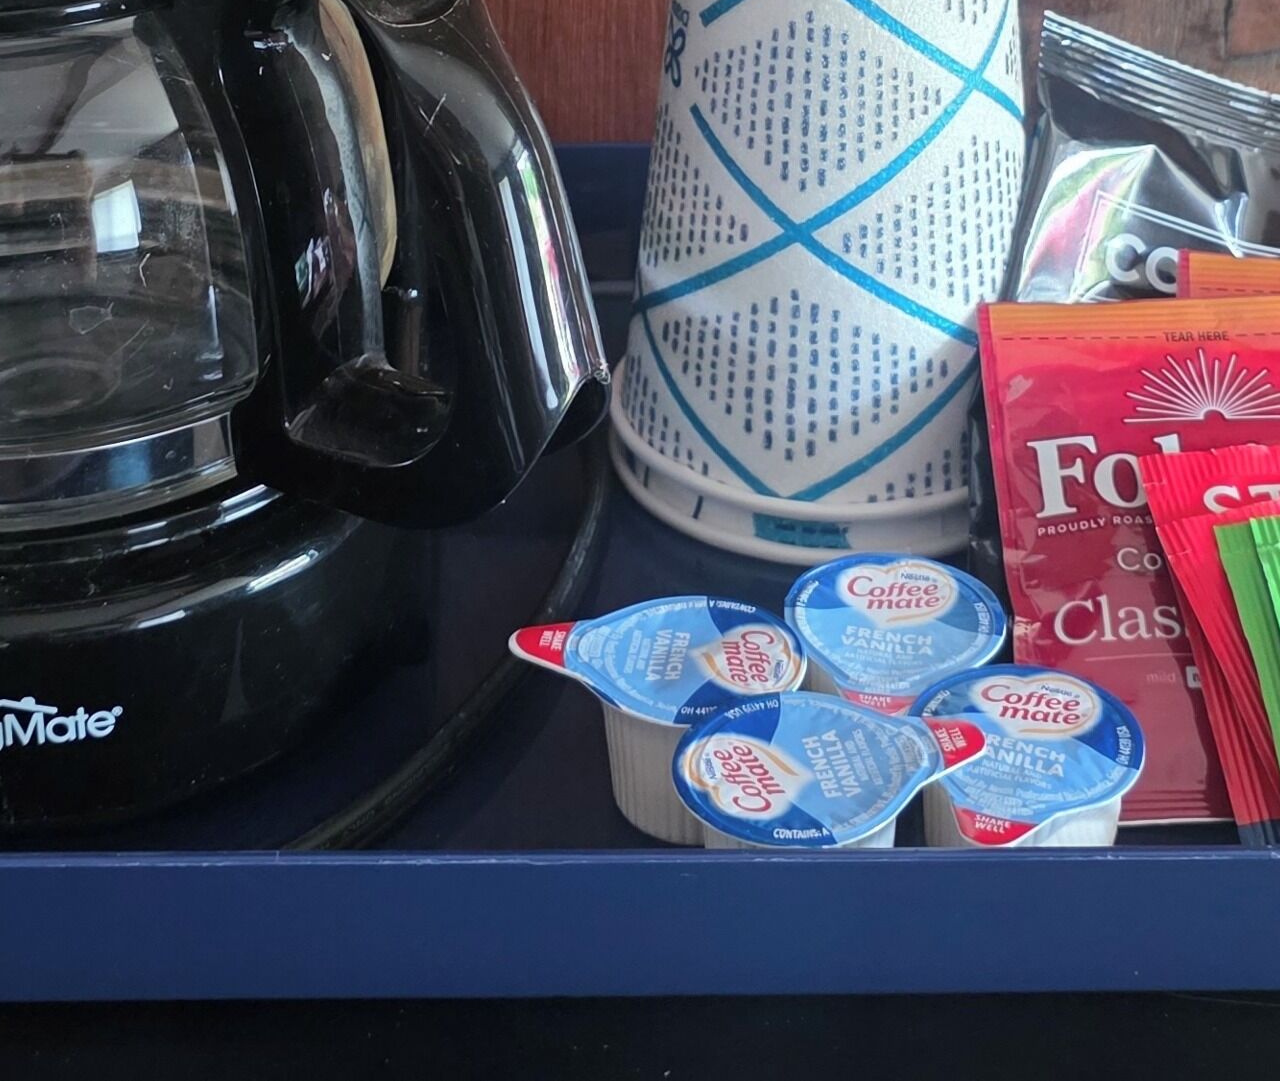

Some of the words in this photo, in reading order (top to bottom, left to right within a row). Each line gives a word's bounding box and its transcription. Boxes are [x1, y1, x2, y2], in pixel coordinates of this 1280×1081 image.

[1105, 233, 1179, 294] CO
[1163, 332, 1195, 343] TEAR
[1198, 330, 1230, 341] HERE
[1026, 433, 1181, 519] Fo
[1037, 517, 1106, 537] PROUDLY
[1117, 547, 1162, 571] Co
[847, 575, 939, 598] Coffee
[867, 595, 941, 610] mate
[1054, 594, 1182, 646] Clas
[538, 630, 554, 647] WELL
[550, 630, 567, 652] SHAKE
[841, 634, 933, 655] VANILLA
[845, 625, 933, 646] FRENCH
[645, 629, 673, 682] VANILLA
[663, 631, 691, 681] FRENCH
[722, 641, 749, 685] mate
[741, 630, 775, 684] Coffee
[981, 683, 1081, 711] Coffee
[999, 703, 1081, 725] mate
[934, 727, 955, 752] SHAKE
[949, 727, 968, 749] WELL
[986, 734, 1066, 763] RENCH
[734, 745, 786, 796] mate
[802, 736, 843, 799] FRENCH
[822, 728, 862, 798] VANILLA
[984, 748, 1065, 777] ANILLA
[713, 750, 773, 813] Coffee
[974, 813, 1012, 829] SHAKE
[975, 821, 1006, 834] WELL
